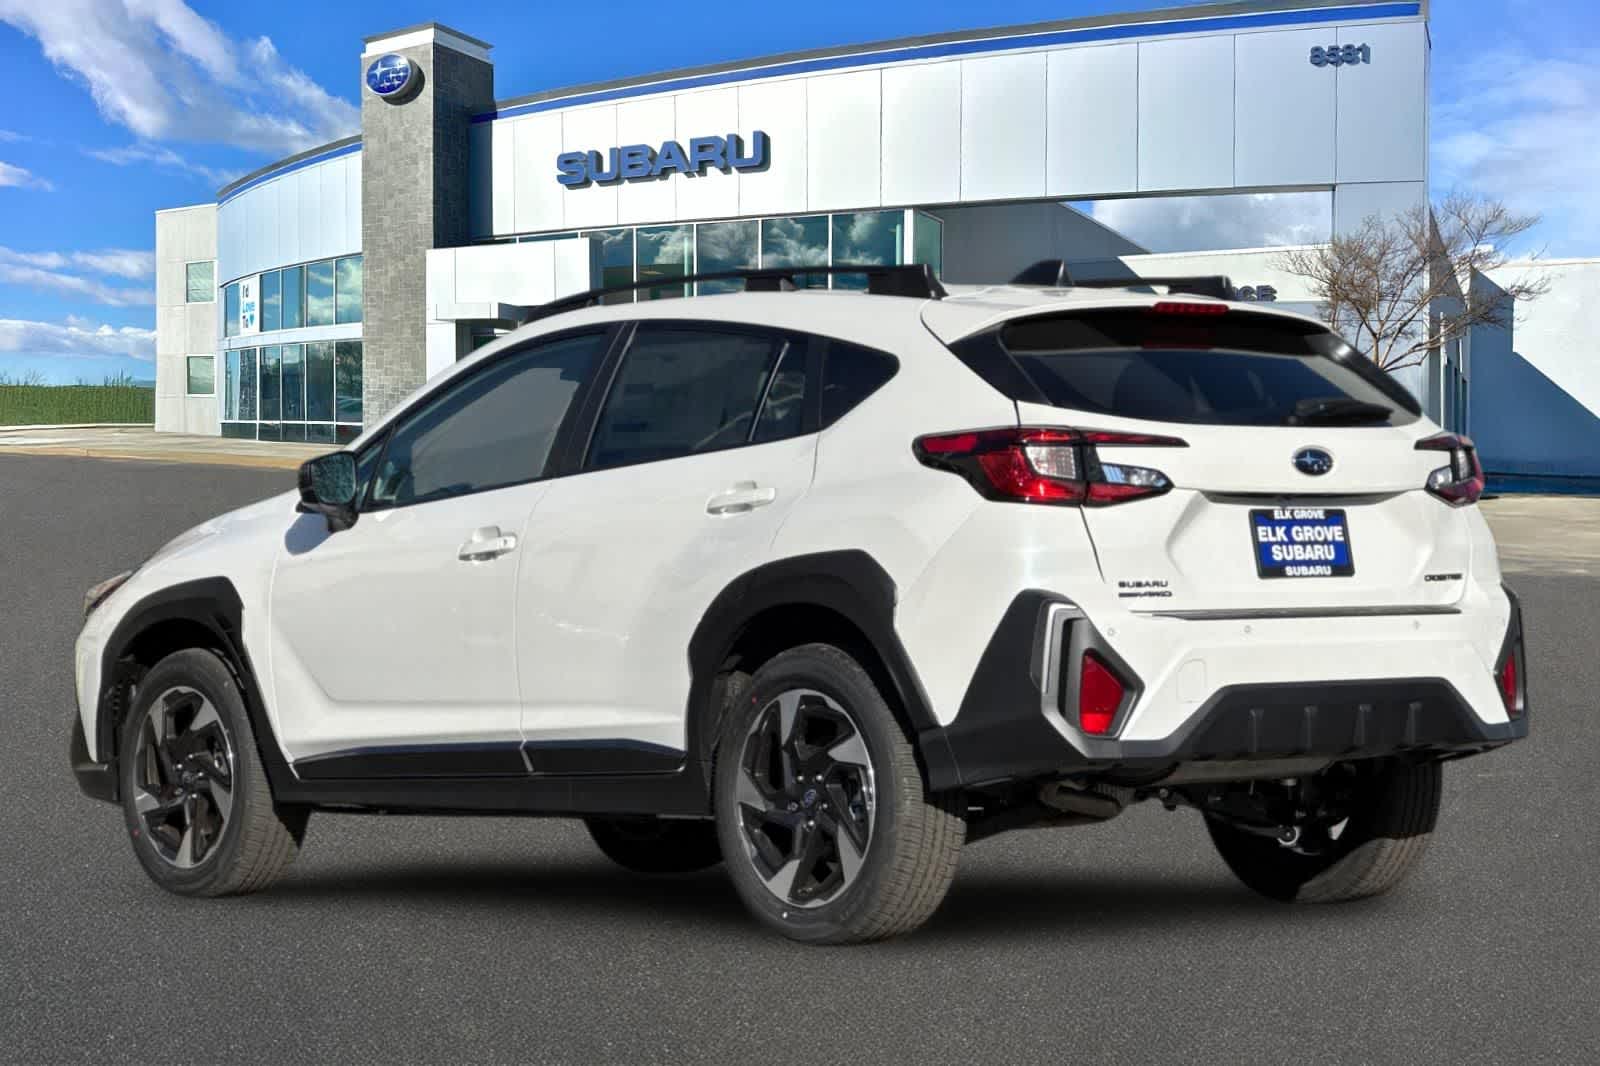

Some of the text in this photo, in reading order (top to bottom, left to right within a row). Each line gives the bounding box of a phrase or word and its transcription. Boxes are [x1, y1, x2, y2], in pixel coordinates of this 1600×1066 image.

[556, 130, 770, 190] SUBARU
[1273, 509, 1325, 519] ELK GROVE
[1257, 526, 1344, 541] ELK GROVE
[1271, 544, 1335, 561] SUBARU
[1285, 565, 1332, 576] SUBARU
[1118, 580, 1168, 588] SUBARU
